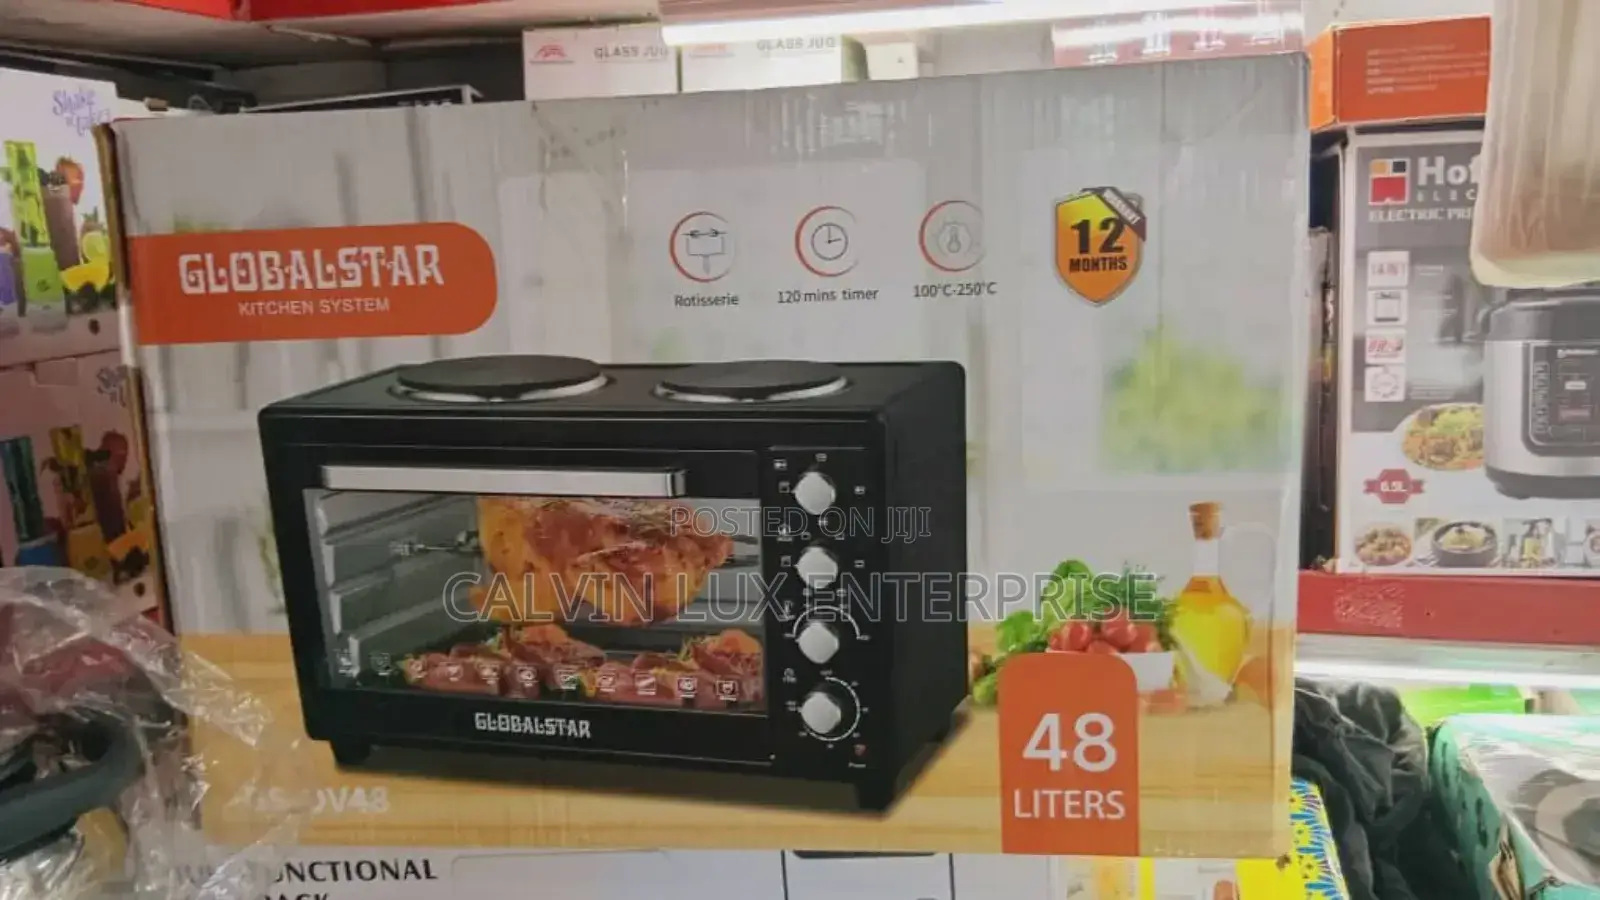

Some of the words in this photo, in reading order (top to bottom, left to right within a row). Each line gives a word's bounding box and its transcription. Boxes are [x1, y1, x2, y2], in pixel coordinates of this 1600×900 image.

[1069, 217, 1125, 255] 12
[178, 244, 445, 295] GLOBALSTAR
[1068, 256, 1129, 273] MONTHS
[238, 300, 314, 318] KITCHEN
[320, 297, 391, 315] SYSTEM
[674, 293, 740, 308] Rotisserie
[777, 290, 801, 304] 120
[804, 289, 837, 302] mins
[842, 287, 880, 301] timer
[475, 711, 591, 739] GLOBALSTAR
[1022, 711, 1118, 773] 48
[1014, 788, 1126, 819] LITERS
[276, 858, 438, 884] NCTIONAL
